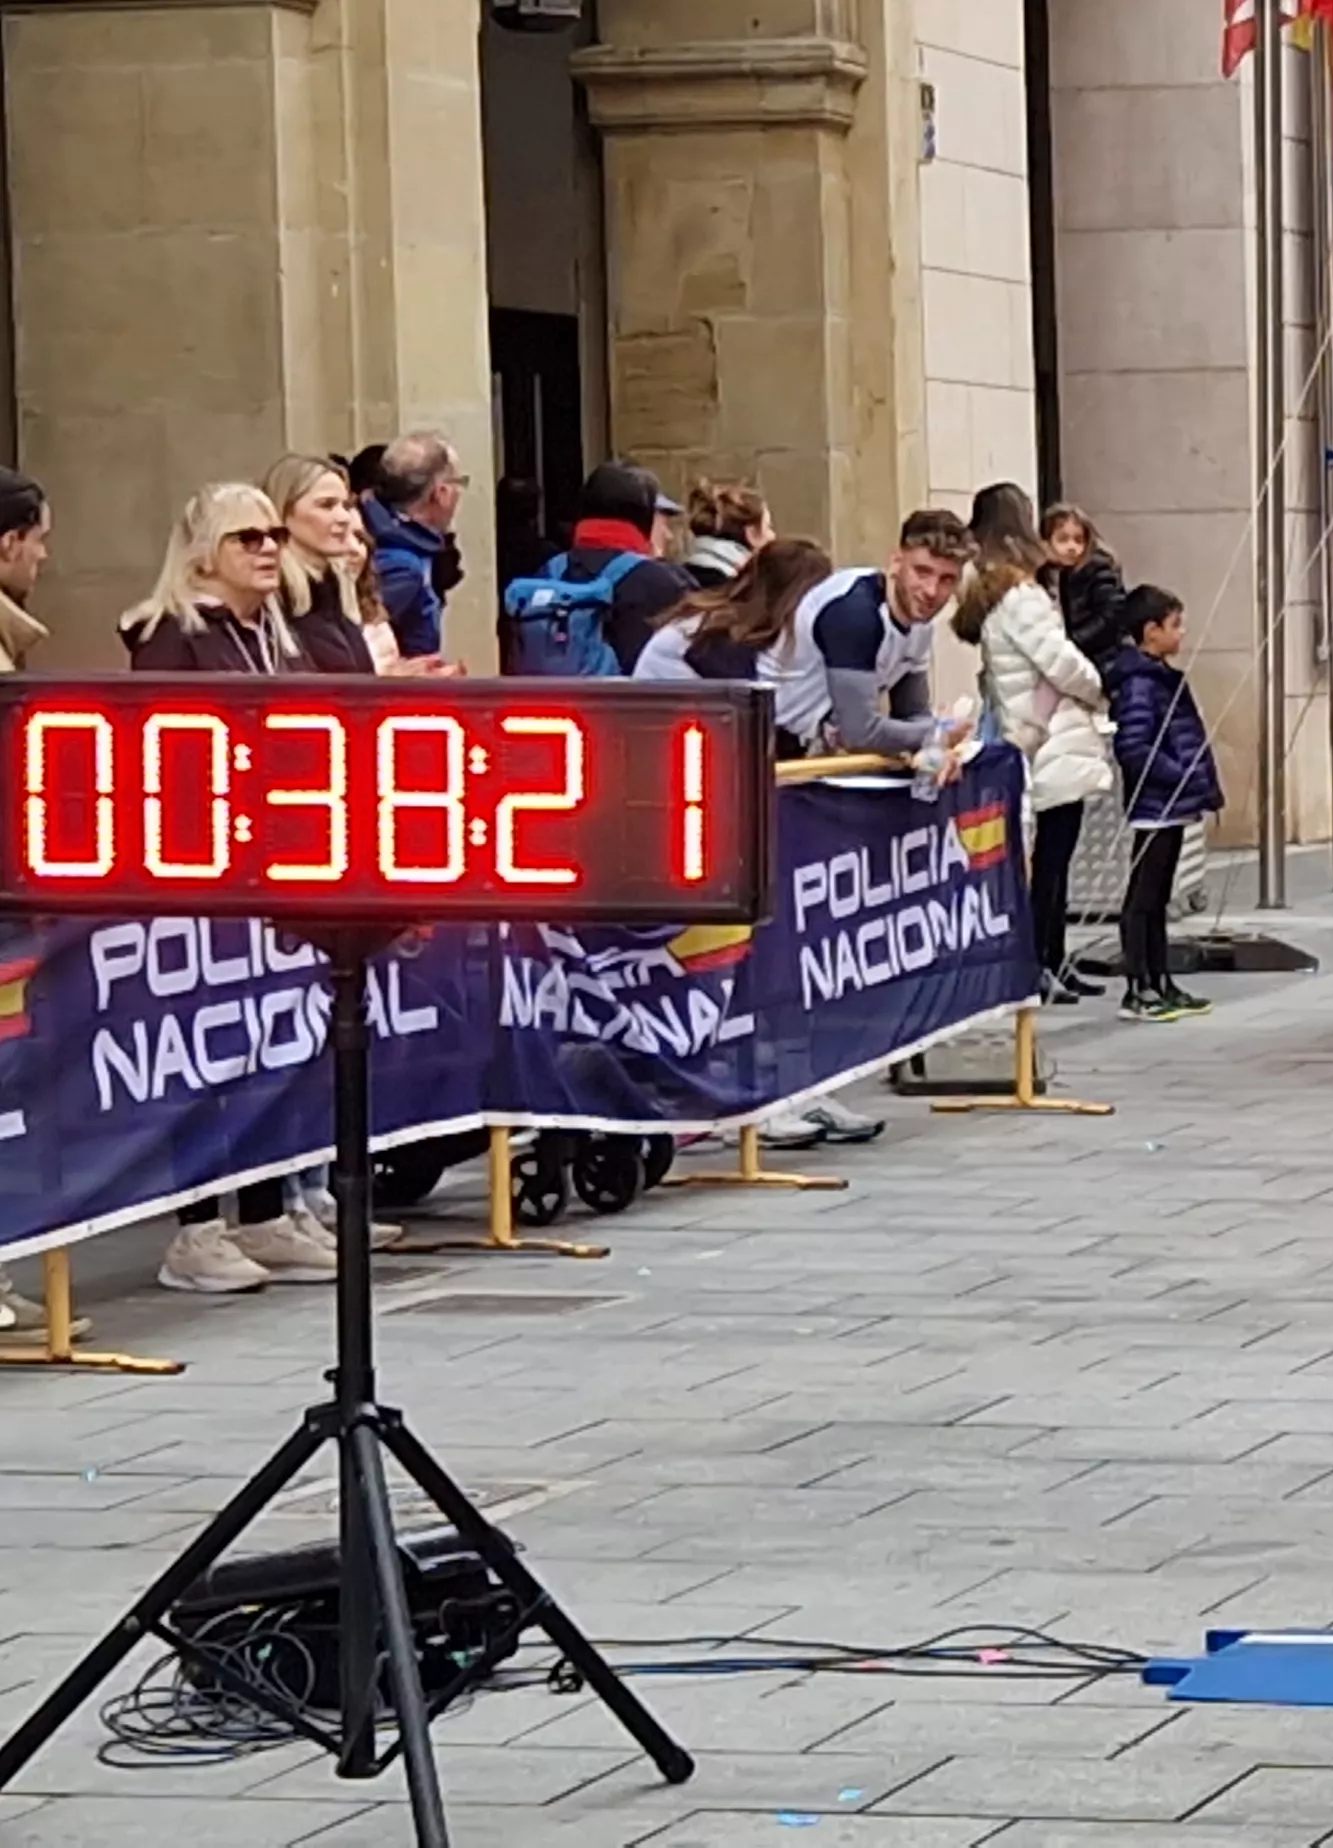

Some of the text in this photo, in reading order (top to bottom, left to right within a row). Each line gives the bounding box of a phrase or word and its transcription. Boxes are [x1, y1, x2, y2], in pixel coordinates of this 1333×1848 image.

[26, 711, 704, 884] 00:38:21
[793, 816, 971, 933] POLICIA
[799, 880, 1010, 1011] NACIONAL
